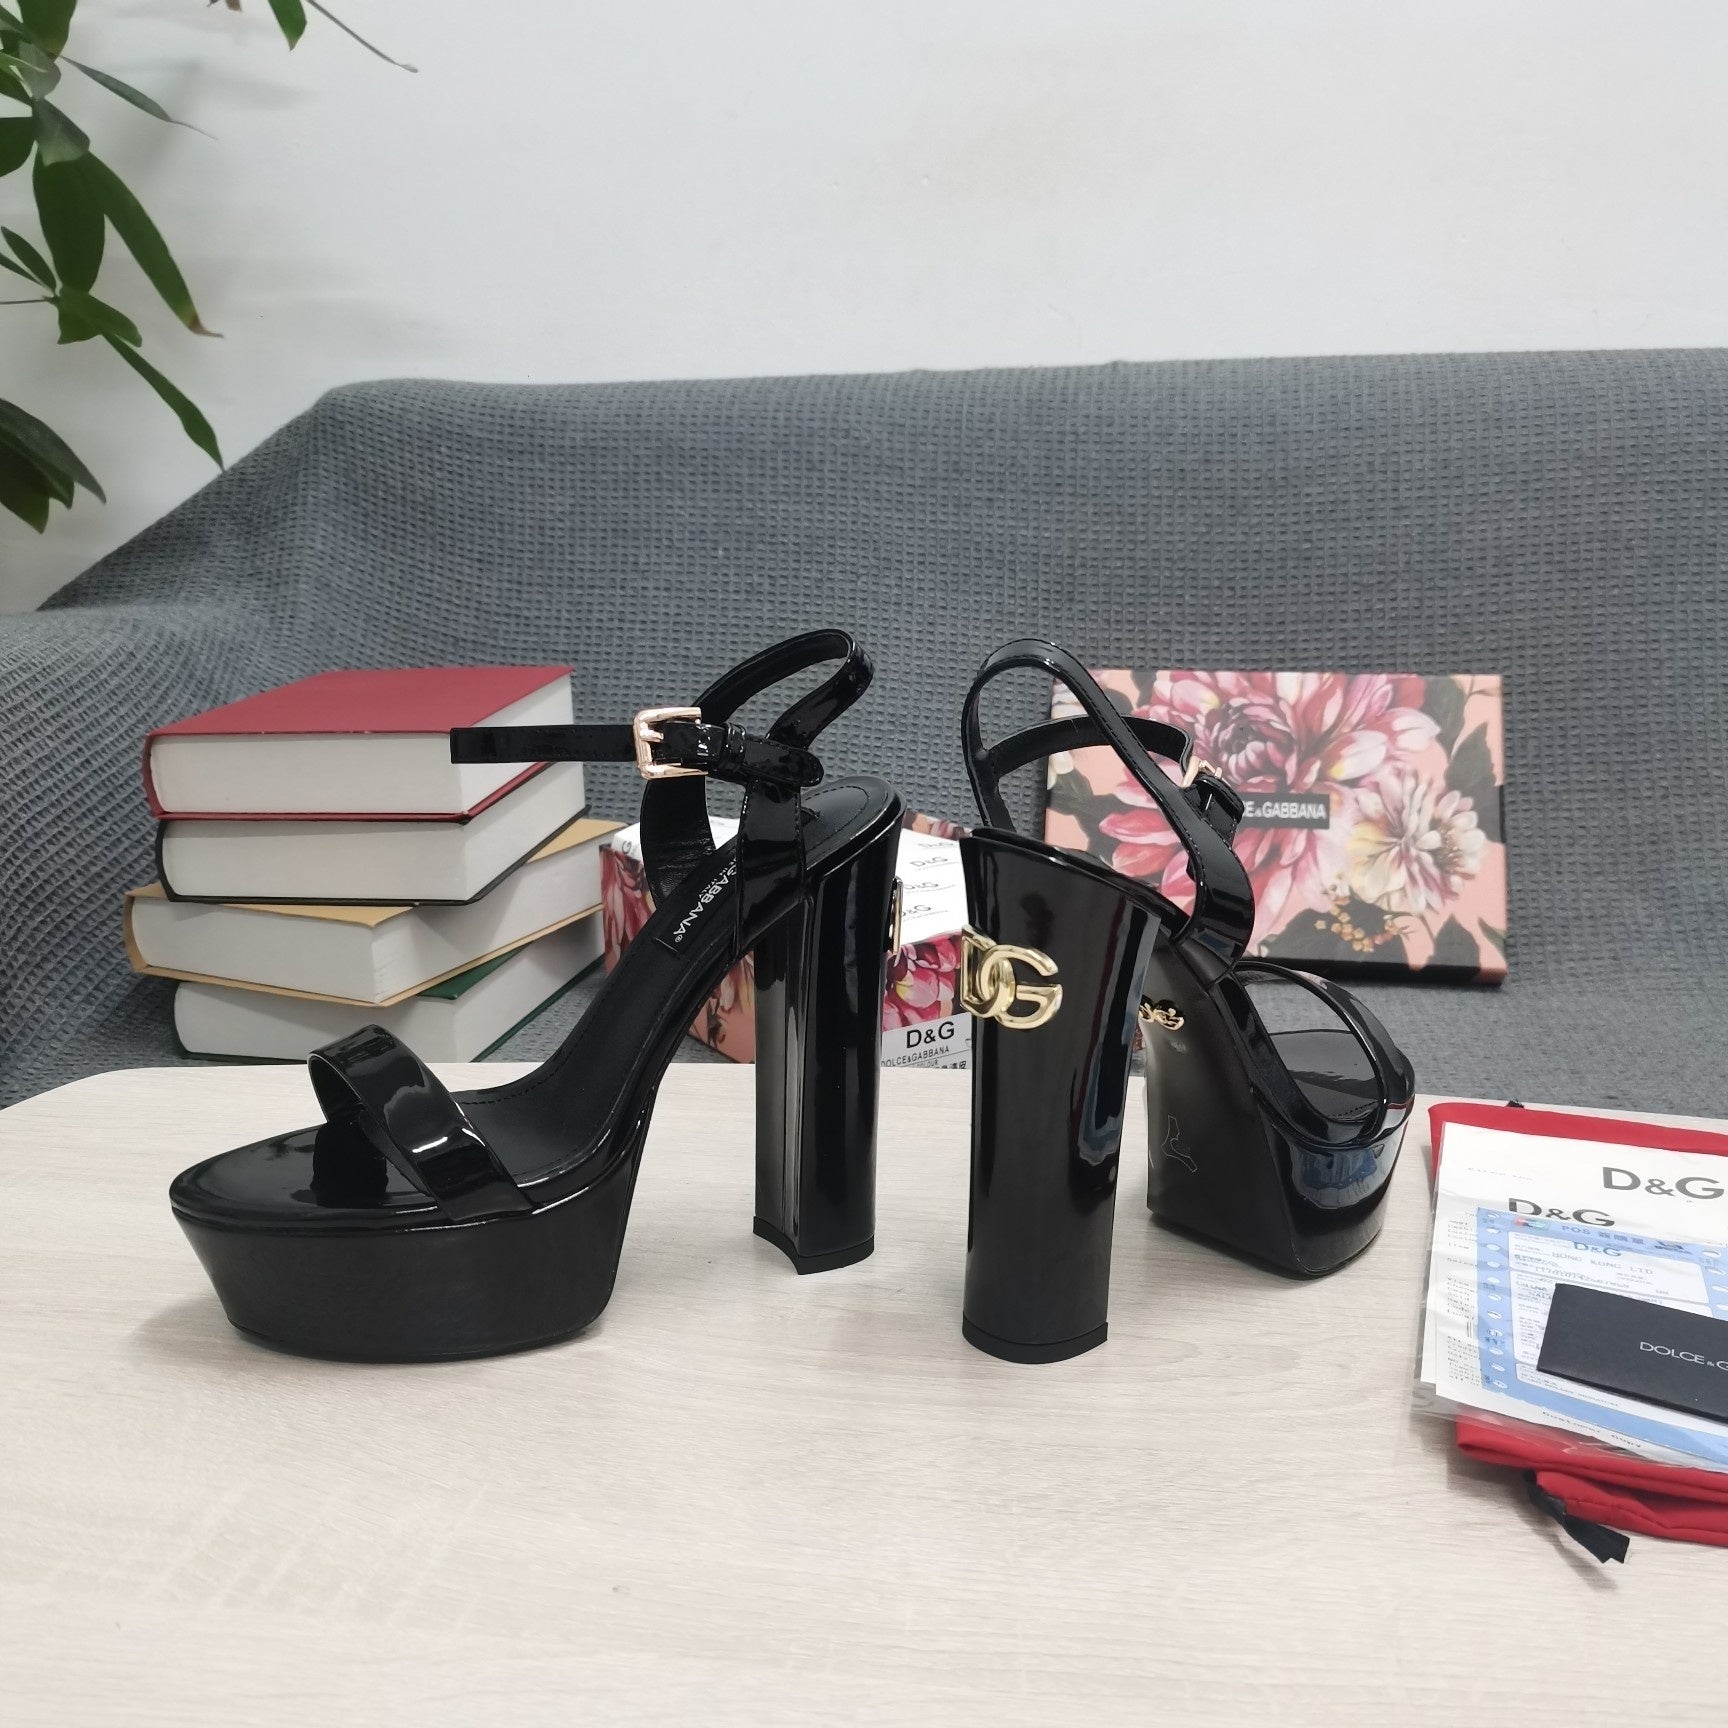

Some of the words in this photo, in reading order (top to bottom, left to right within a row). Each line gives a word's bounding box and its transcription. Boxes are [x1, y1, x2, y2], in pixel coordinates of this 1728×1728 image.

[1242, 800, 1328, 820] E&GABBANA
[906, 1020, 955, 1049] D&G
[1602, 1166, 1725, 1199] D&G
[1508, 1197, 1615, 1226] D&G
[1561, 1225, 1591, 1235] POS
[1573, 1241, 1622, 1257] D&G
